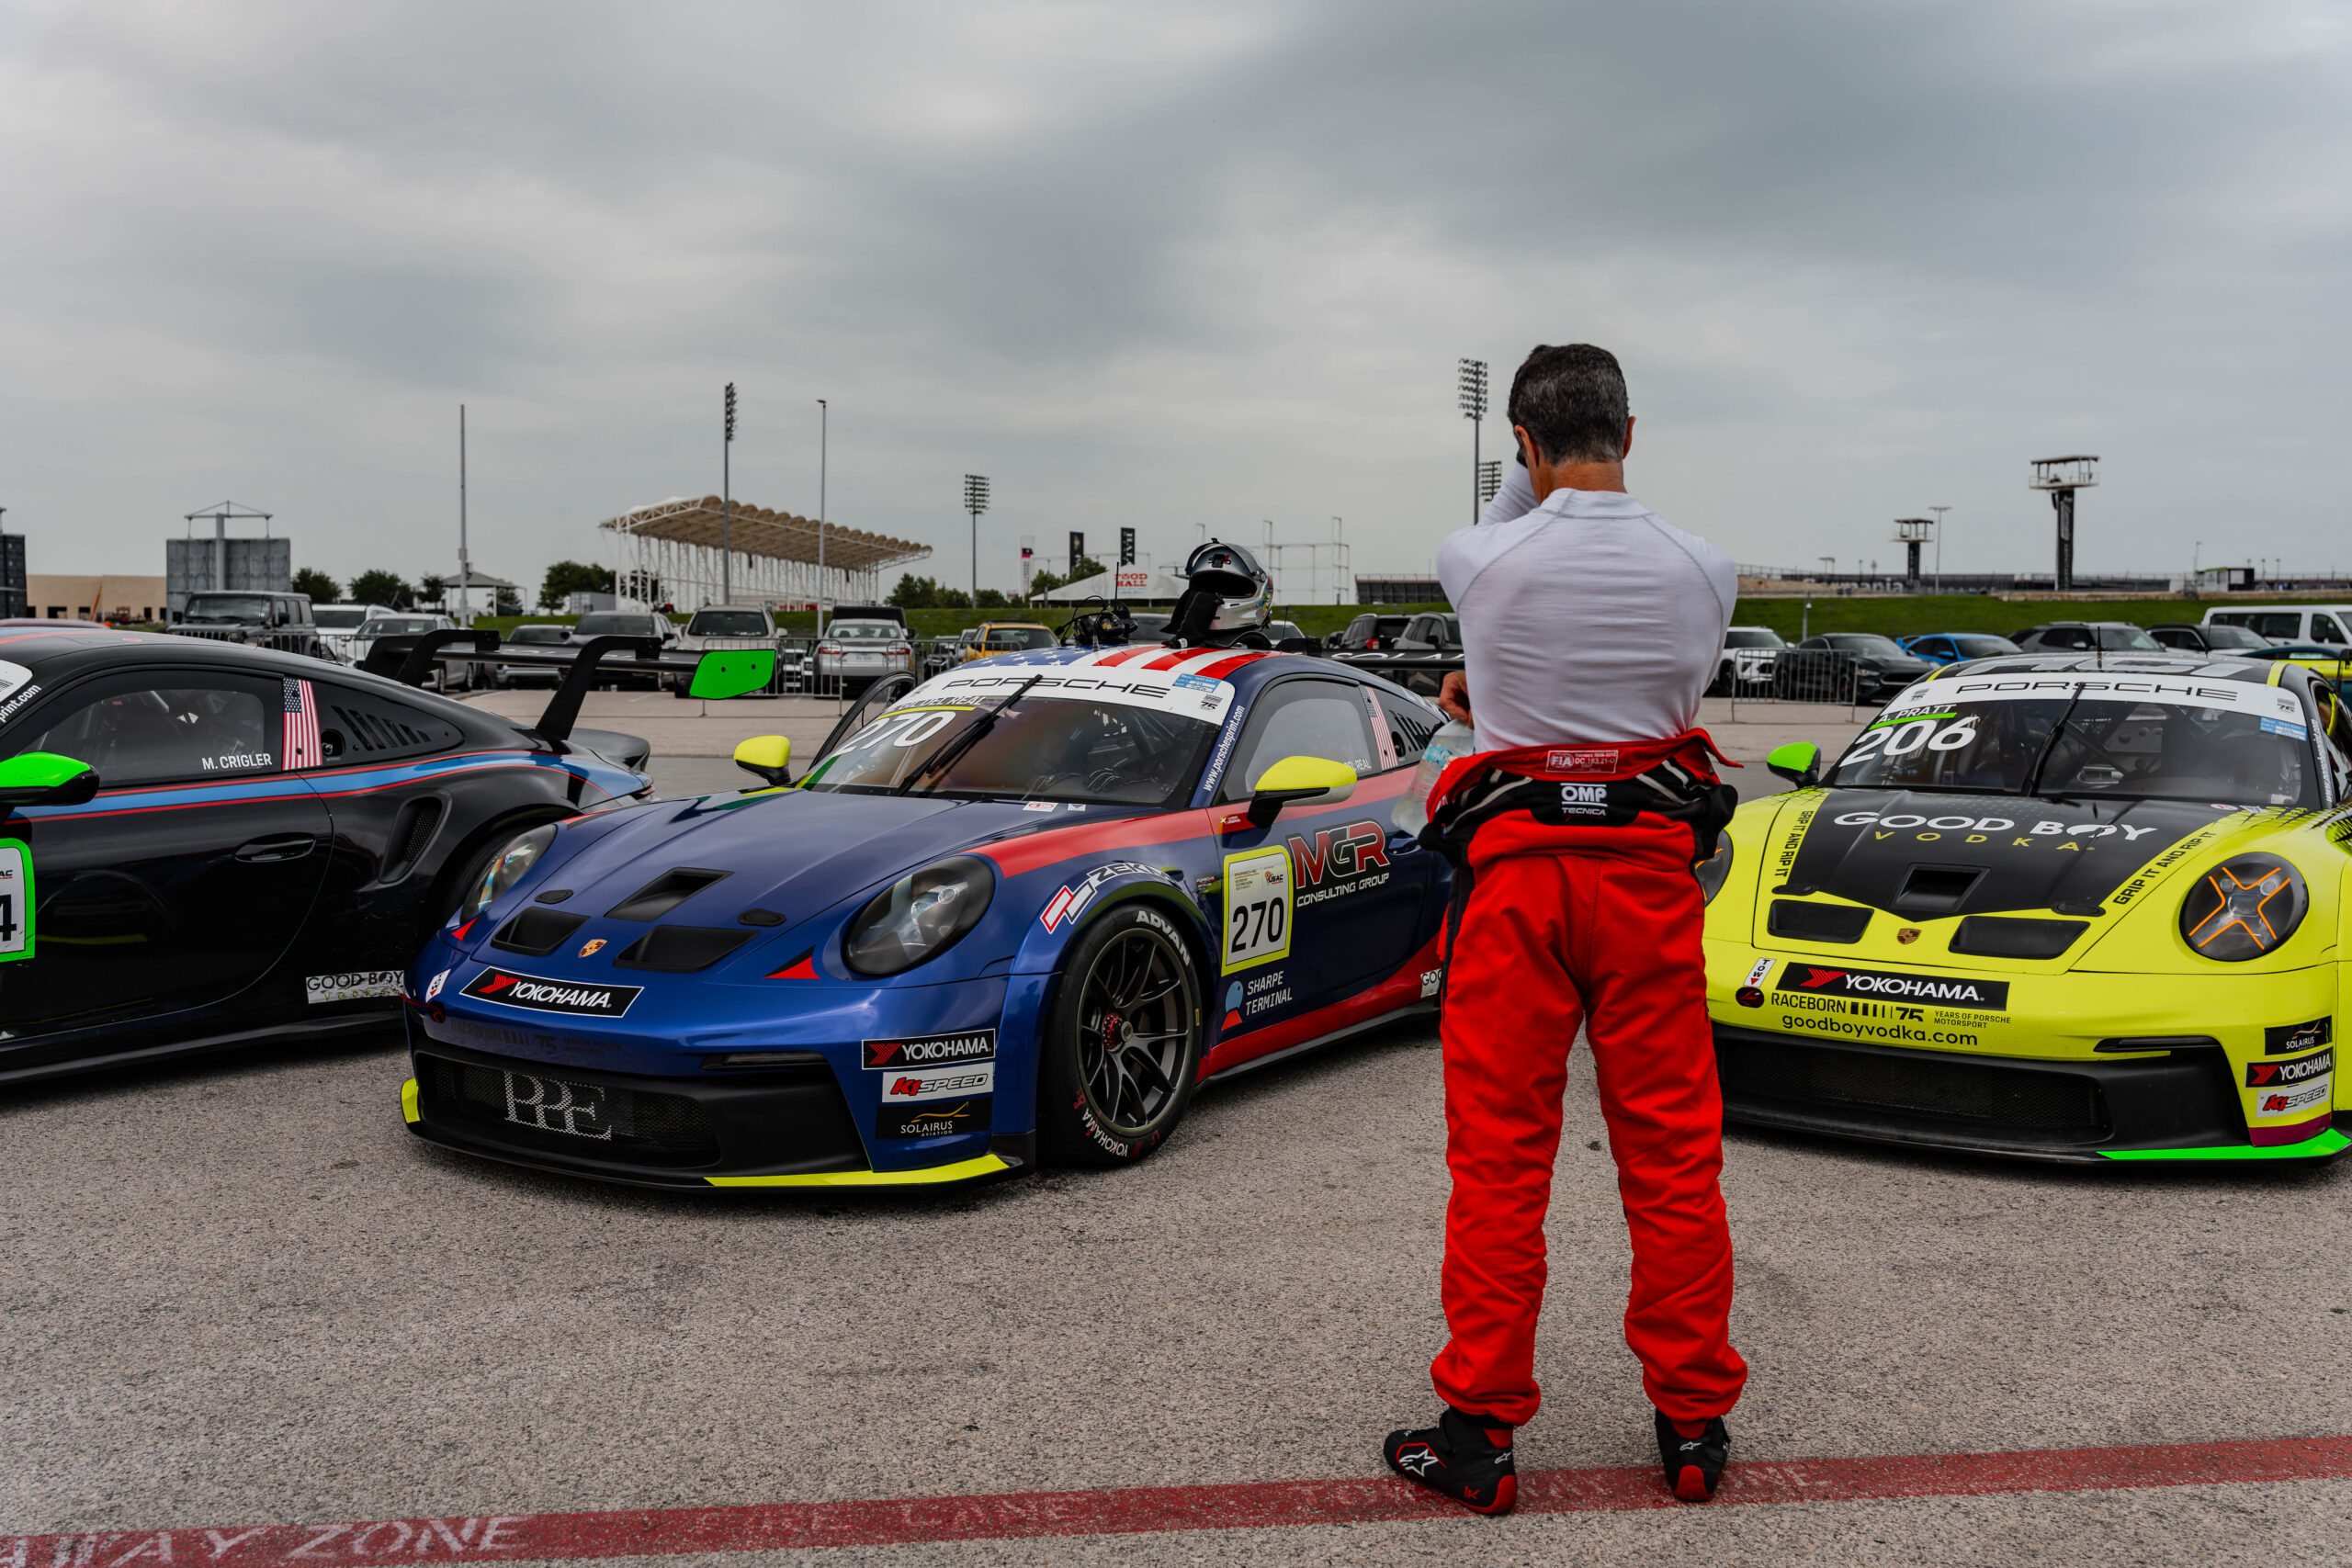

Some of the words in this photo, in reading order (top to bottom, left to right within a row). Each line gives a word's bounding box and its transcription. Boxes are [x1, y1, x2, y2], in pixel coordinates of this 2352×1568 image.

[942, 676, 1170, 698] PORSCHE
[1956, 681, 2238, 701] PORSCHE
[920, 697, 946, 706] DEL
[947, 695, 986, 705] REAL
[1201, 701, 1218, 709] 75
[1897, 704, 1957, 717] PRATT
[2278, 704, 2295, 712] 75
[829, 711, 956, 759] 270
[1838, 716, 1980, 767] 206
[1204, 705, 1245, 792] www.porschesprint.com
[201, 758, 219, 771] M.
[220, 753, 272, 769] CRIGLER
[1552, 756, 1572, 767] FIA
[1561, 785, 1607, 802] OMP
[1562, 807, 1606, 816] TECNICA
[1834, 811, 2015, 832] GOOD
[2029, 820, 2157, 840] BOY
[1784, 833, 1802, 849] AND
[1874, 831, 2080, 852] VODKA
[1288, 820, 1391, 889] MGR
[1779, 851, 1795, 866] RIP
[1269, 874, 1283, 883] USAC
[1774, 868, 1789, 877] IT
[2112, 878, 2145, 905] GRIP
[2141, 868, 2160, 878] IT
[2155, 851, 2187, 867] AND
[2178, 838, 2202, 850] RIP
[1296, 882, 1356, 908] CONSULTING
[1358, 873, 1389, 894] GROUP
[0, 894, 17, 942] 4
[1231, 897, 1284, 953] 270
[1136, 910, 1190, 966] ADVAN
[1422, 969, 1442, 986] GOO
[1753, 959, 1770, 977] TOW
[307, 973, 362, 990] GOOD
[368, 971, 404, 986] BOY
[1247, 970, 1284, 996] SHARPE
[1845, 974, 1980, 1001] YOKOHAMA
[508, 981, 610, 1008] YOKOHAMA
[1246, 987, 1293, 1016] TERMINAL
[1771, 992, 1847, 1013] RACEBORN
[1895, 1006, 1924, 1022] 75
[1934, 1010, 1960, 1019] YEARS
[1973, 1014, 2011, 1023] PORSCHE
[1782, 1015, 1978, 1046] goodboyvodka.com
[1934, 1018, 1987, 1029] MOTORSPORT
[902, 1037, 989, 1060] YOKOHAMA
[2286, 1036, 2314, 1049] SOLAIRUS
[2279, 1053, 2331, 1080] YOKOHAMA
[900, 1121, 953, 1134] SOLAIRUS
[1081, 1107, 1128, 1156] YOKOHAMA
[287, 1516, 530, 1559] ZONE
